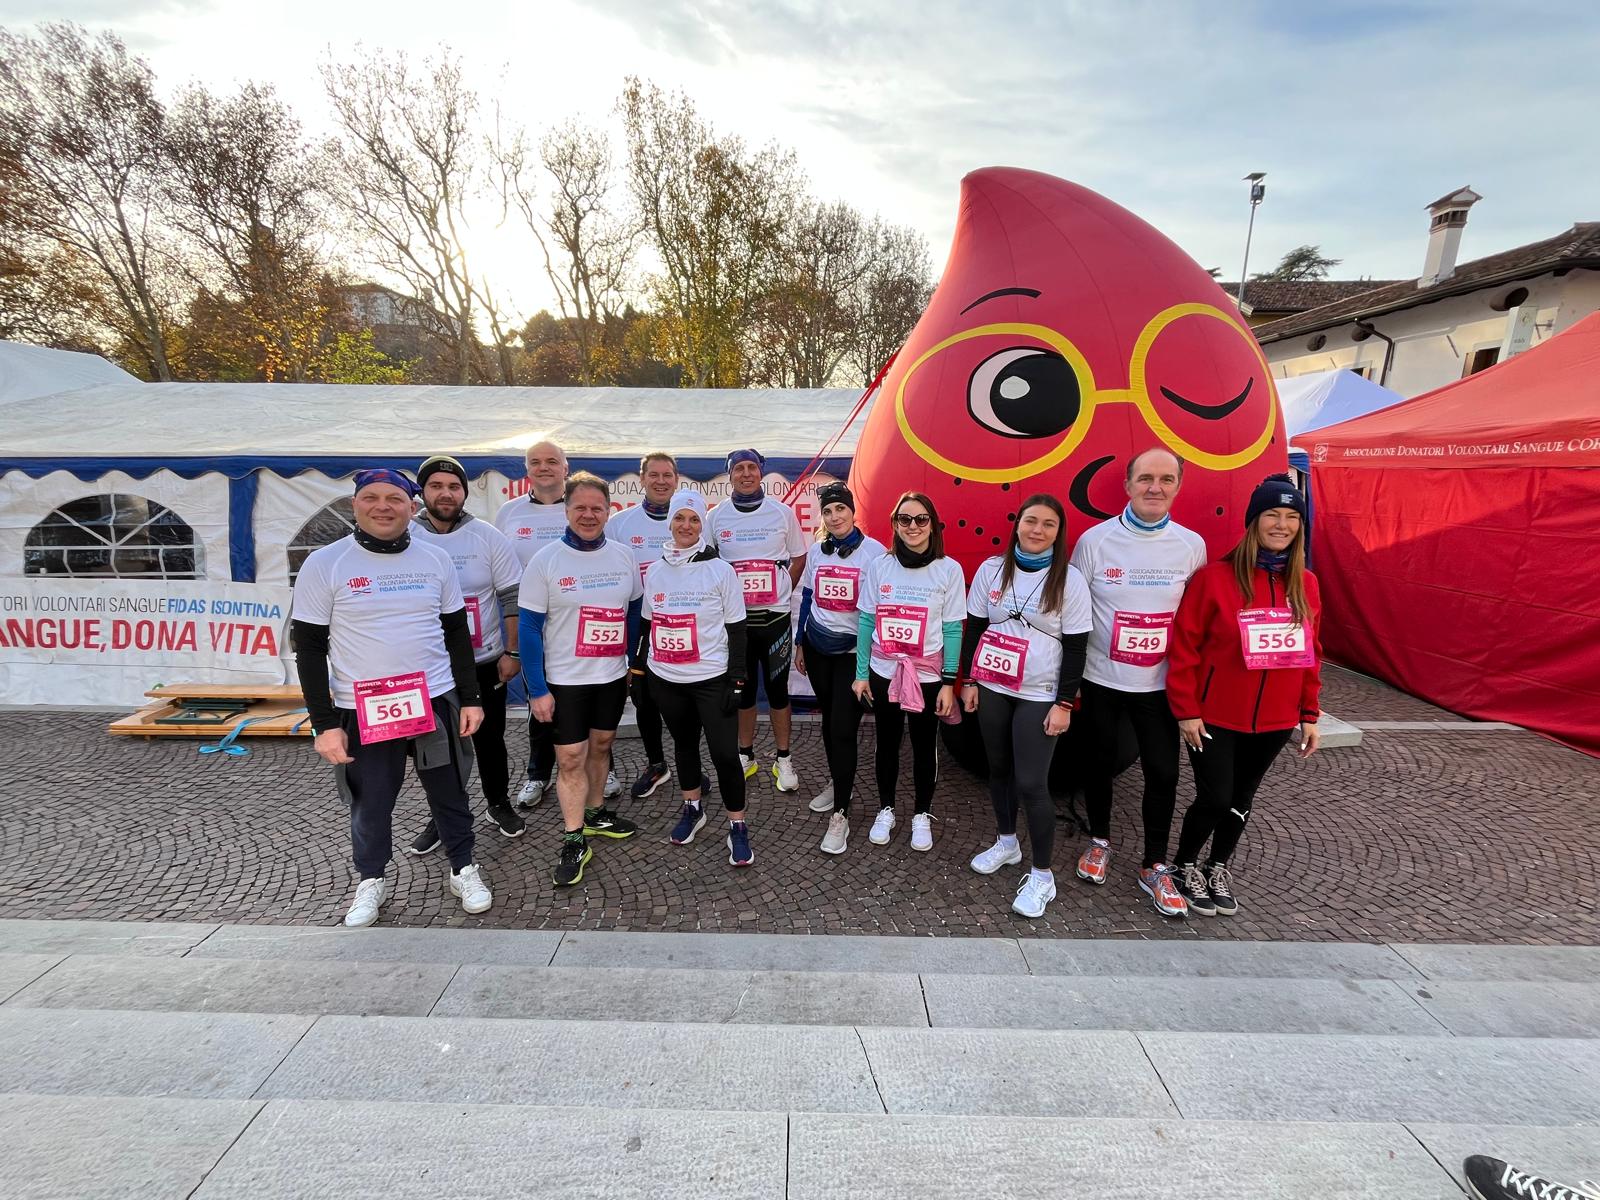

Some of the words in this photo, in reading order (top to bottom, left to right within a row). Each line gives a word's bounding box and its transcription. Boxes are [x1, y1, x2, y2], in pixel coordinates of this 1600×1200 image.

[1511, 441, 1565, 454] SANGUE
[743, 578, 766, 590] 551
[823, 584, 848, 597] 558
[32, 596, 107, 612] VOLONTARI
[109, 597, 166, 613] SANGUE
[168, 600, 206, 614] FIDAS
[211, 601, 281, 619] ISONTINA
[112, 619, 198, 652] DONA
[208, 621, 278, 656] VITA
[590, 629, 619, 642] 552
[888, 626, 913, 640] 559
[661, 637, 686, 650] 555
[1126, 636, 1160, 650] 549
[1258, 632, 1296, 649] 556
[983, 654, 1011, 672] 550
[376, 700, 412, 721] 561
